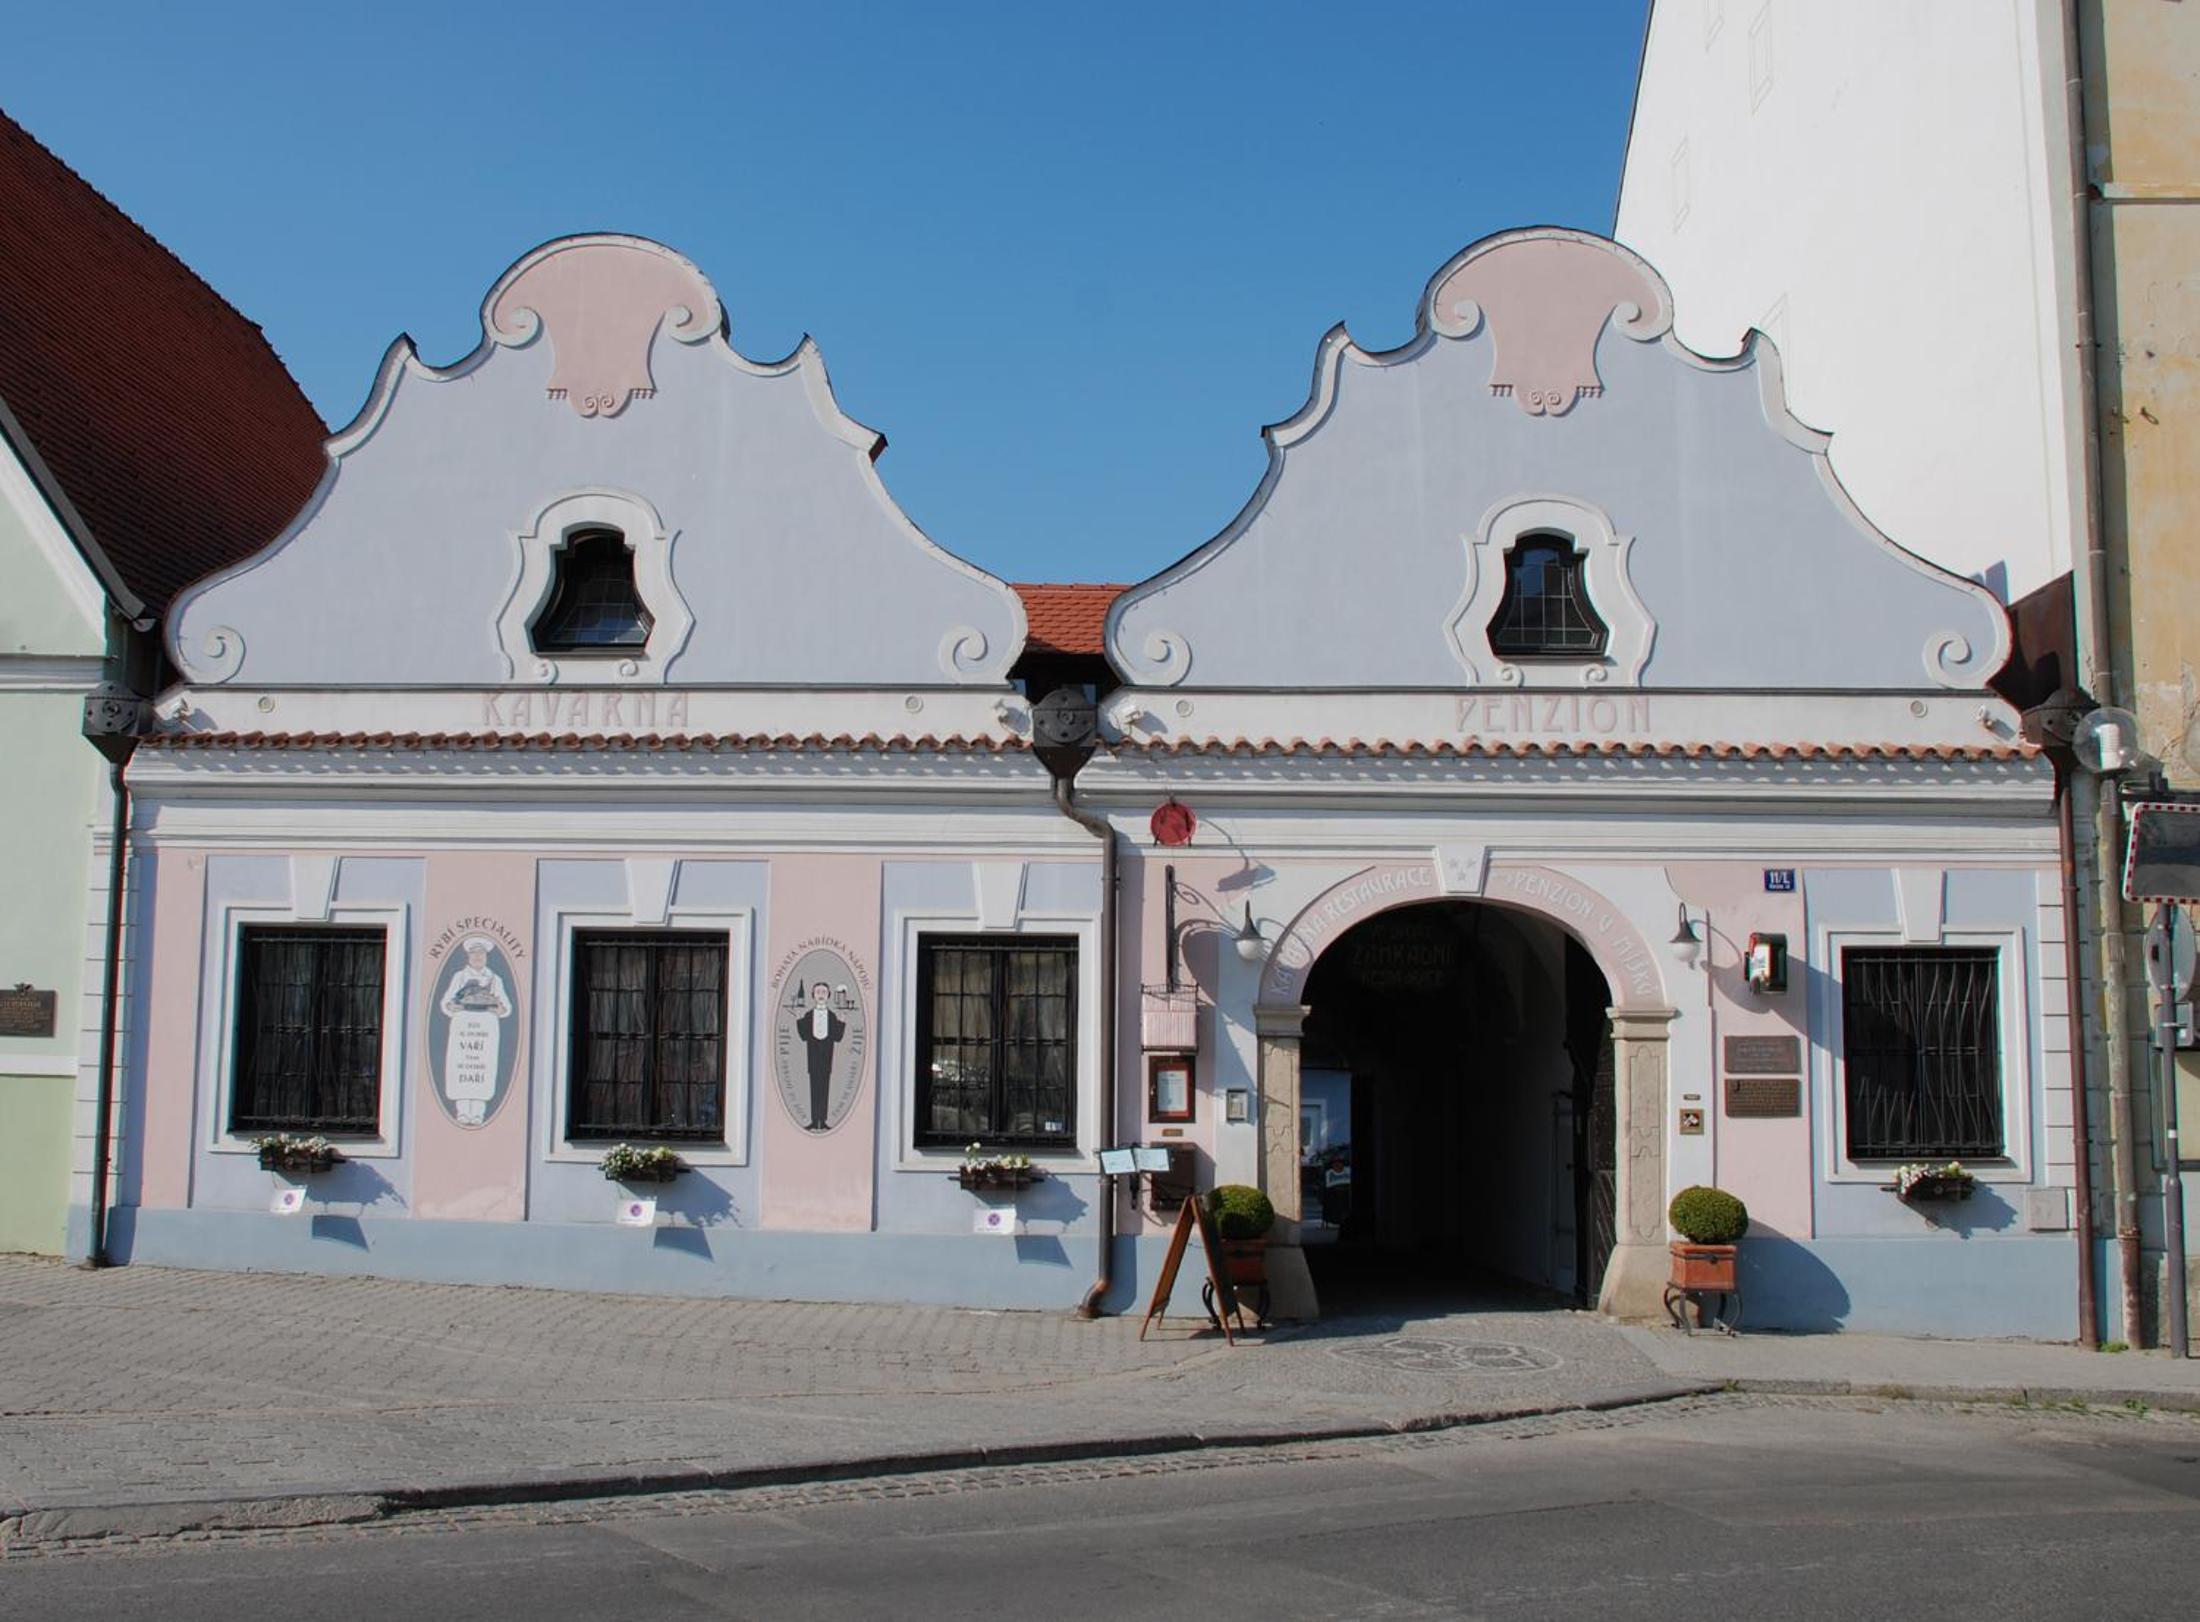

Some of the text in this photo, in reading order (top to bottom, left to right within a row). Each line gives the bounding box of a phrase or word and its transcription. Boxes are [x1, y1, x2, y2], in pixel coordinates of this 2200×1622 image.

[1455, 693, 1651, 733] PENZION
[1324, 866, 1432, 920] RESTAURACE
[1513, 872, 1595, 918] PENZION
[1599, 914, 1615, 936] U
[456, 916, 527, 960] SPECIALITY
[799, 932, 846, 953] NABÍDKA
